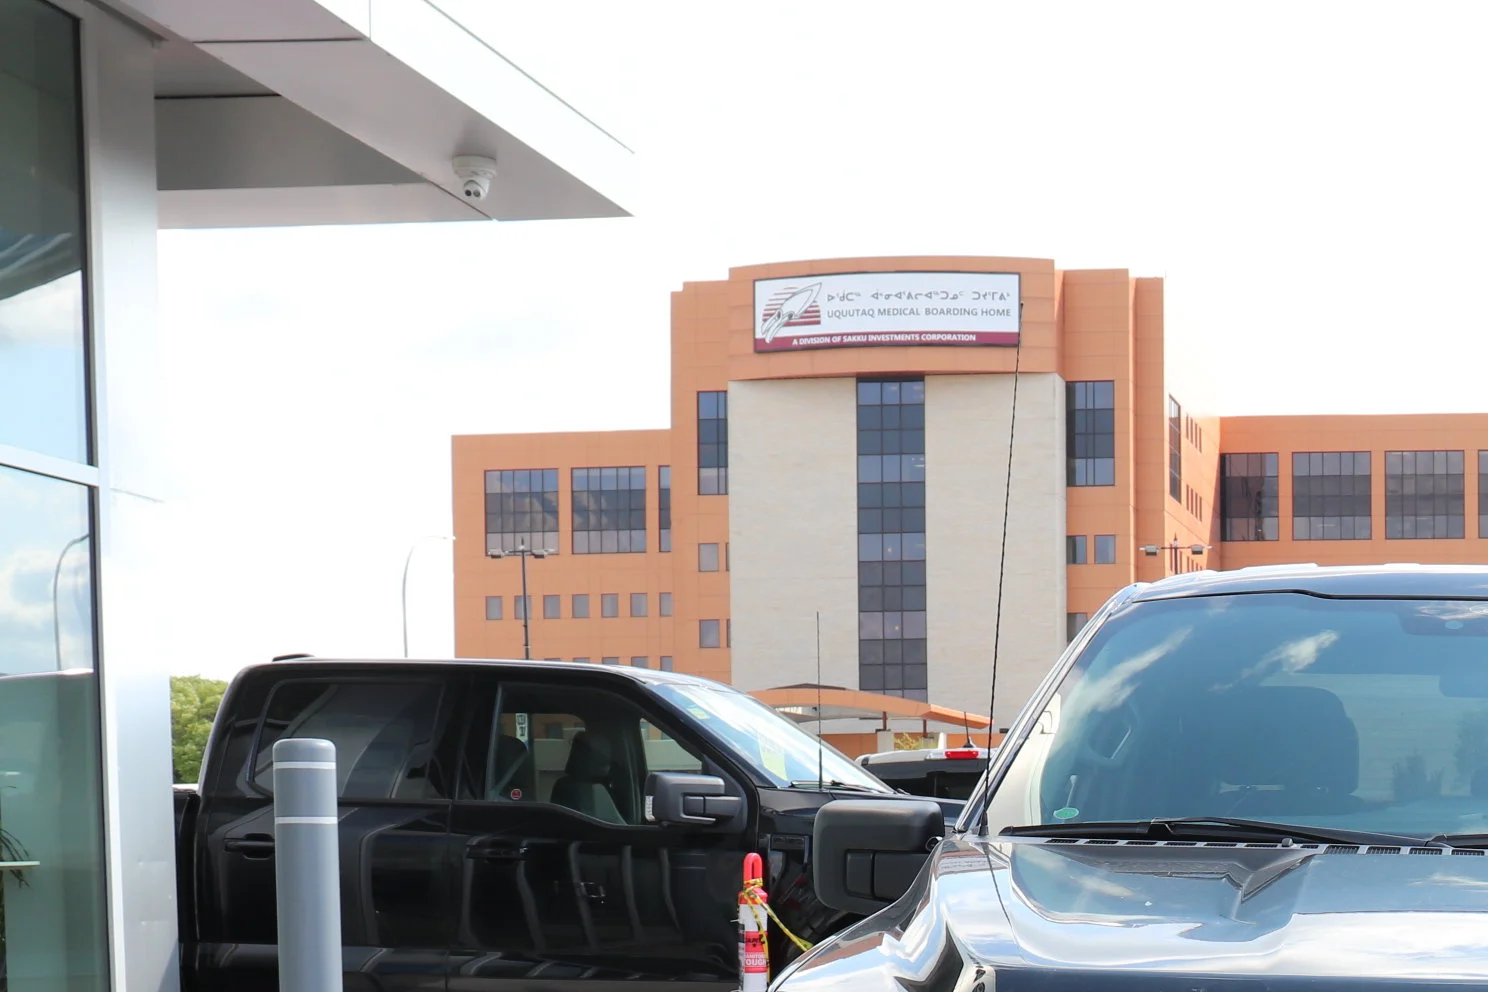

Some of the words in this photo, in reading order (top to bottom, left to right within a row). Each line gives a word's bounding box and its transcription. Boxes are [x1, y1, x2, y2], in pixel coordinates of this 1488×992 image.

[827, 308, 875, 319] UQUUTAQ
[877, 307, 921, 317] MEDICAL
[924, 307, 978, 317] BOARDING
[980, 308, 1012, 317] HOME
[799, 336, 831, 345] DIVISION
[831, 335, 842, 343] OF
[842, 334, 867, 343] SAKKU
[868, 333, 920, 342] INVESTMENTS
[921, 333, 977, 342] CORPORATION
